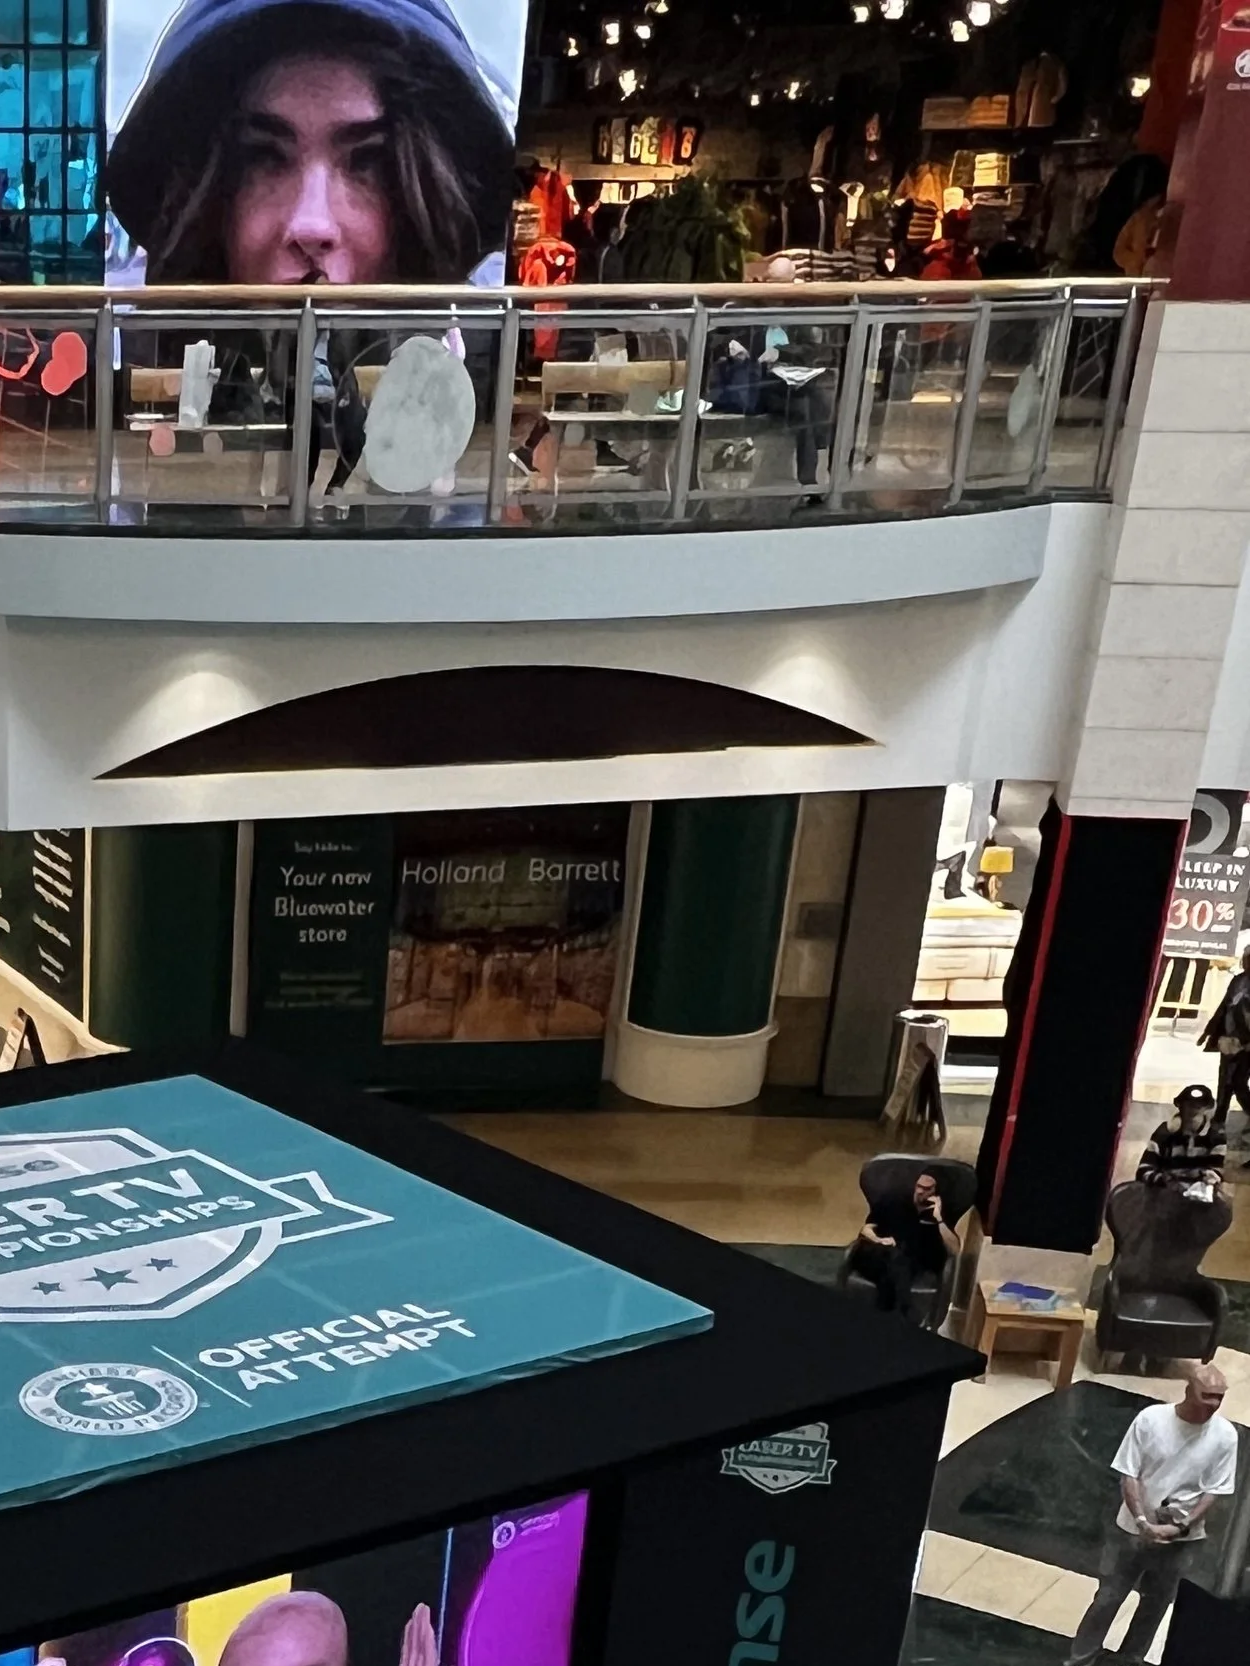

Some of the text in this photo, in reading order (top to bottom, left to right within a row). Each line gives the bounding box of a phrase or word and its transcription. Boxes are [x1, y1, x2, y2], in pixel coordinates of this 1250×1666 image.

[280, 866, 326, 887] Your
[401, 858, 621, 885] Holland Barrett
[274, 897, 375, 917] Bluewater
[299, 928, 347, 943] store
[70, 1168, 205, 1210] TV
[198, 1303, 453, 1368] OFFICIAL
[236, 1318, 477, 1391] ATTEMPT
